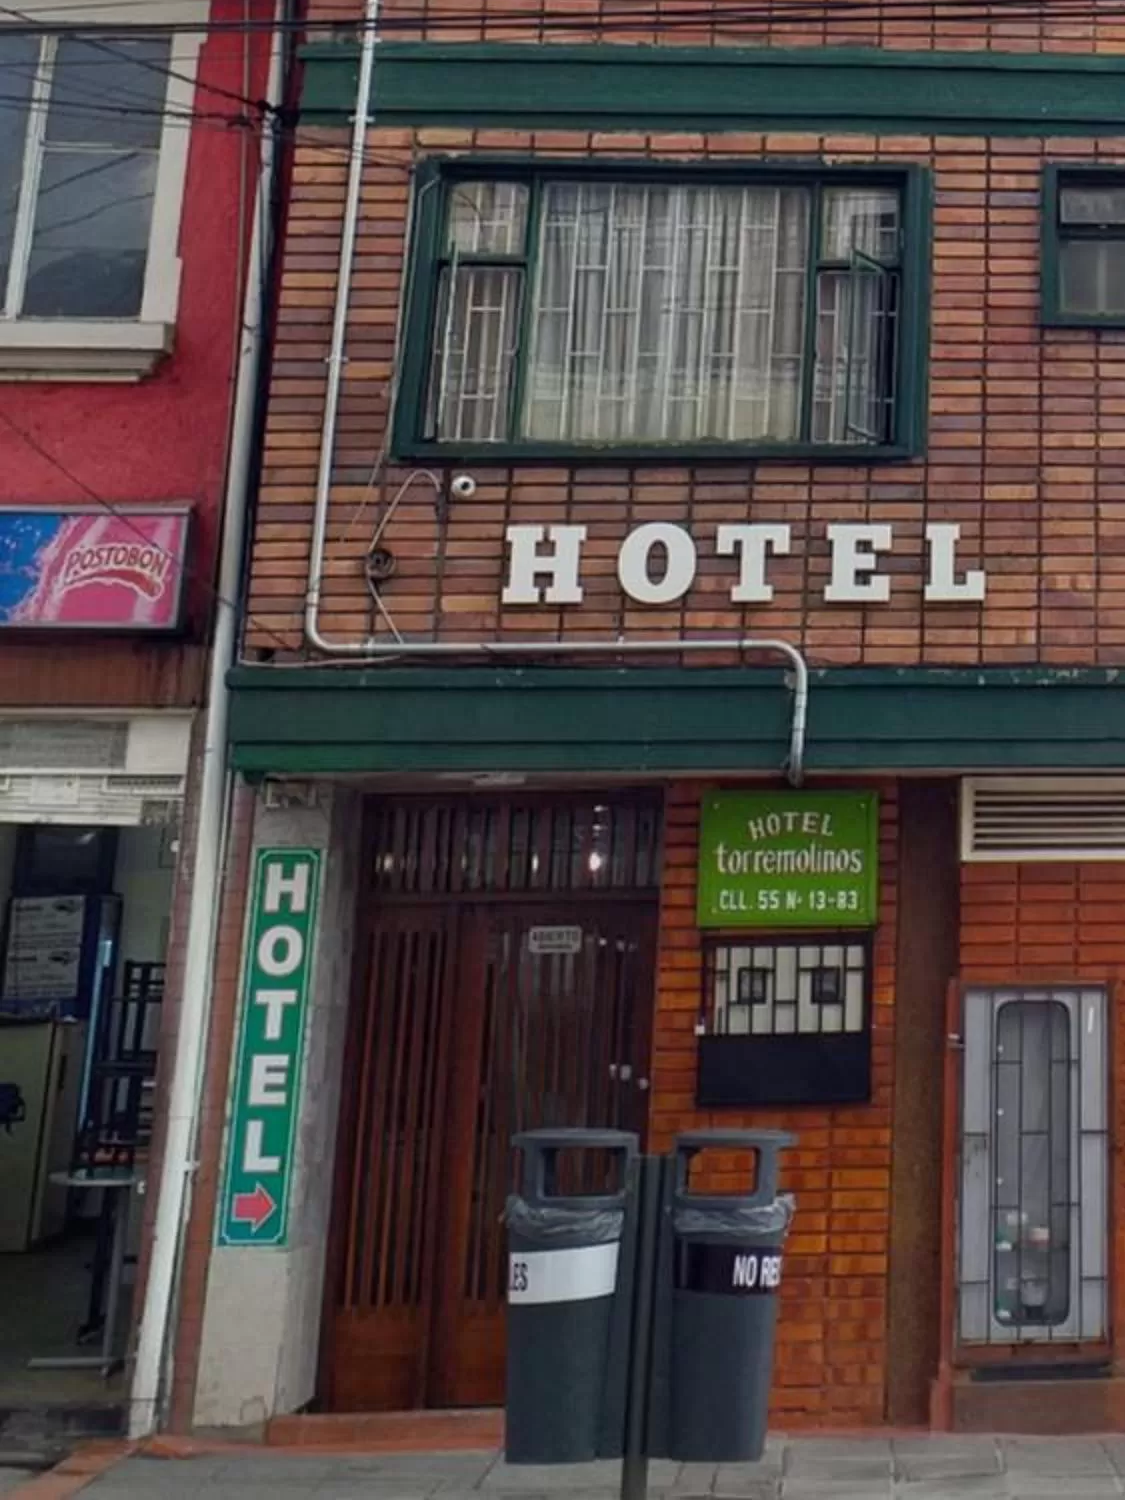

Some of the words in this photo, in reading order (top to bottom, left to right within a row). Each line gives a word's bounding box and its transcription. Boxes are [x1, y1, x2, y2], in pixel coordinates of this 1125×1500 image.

[501, 522, 986, 603] HOTEL
[749, 811, 833, 841] HOTEL
[716, 841, 862, 874] torremolinos
[758, 889, 780, 910] 55
[809, 889, 858, 910] 13-83
[242, 863, 309, 1173] HOTEL
[732, 1254, 758, 1287] NO
